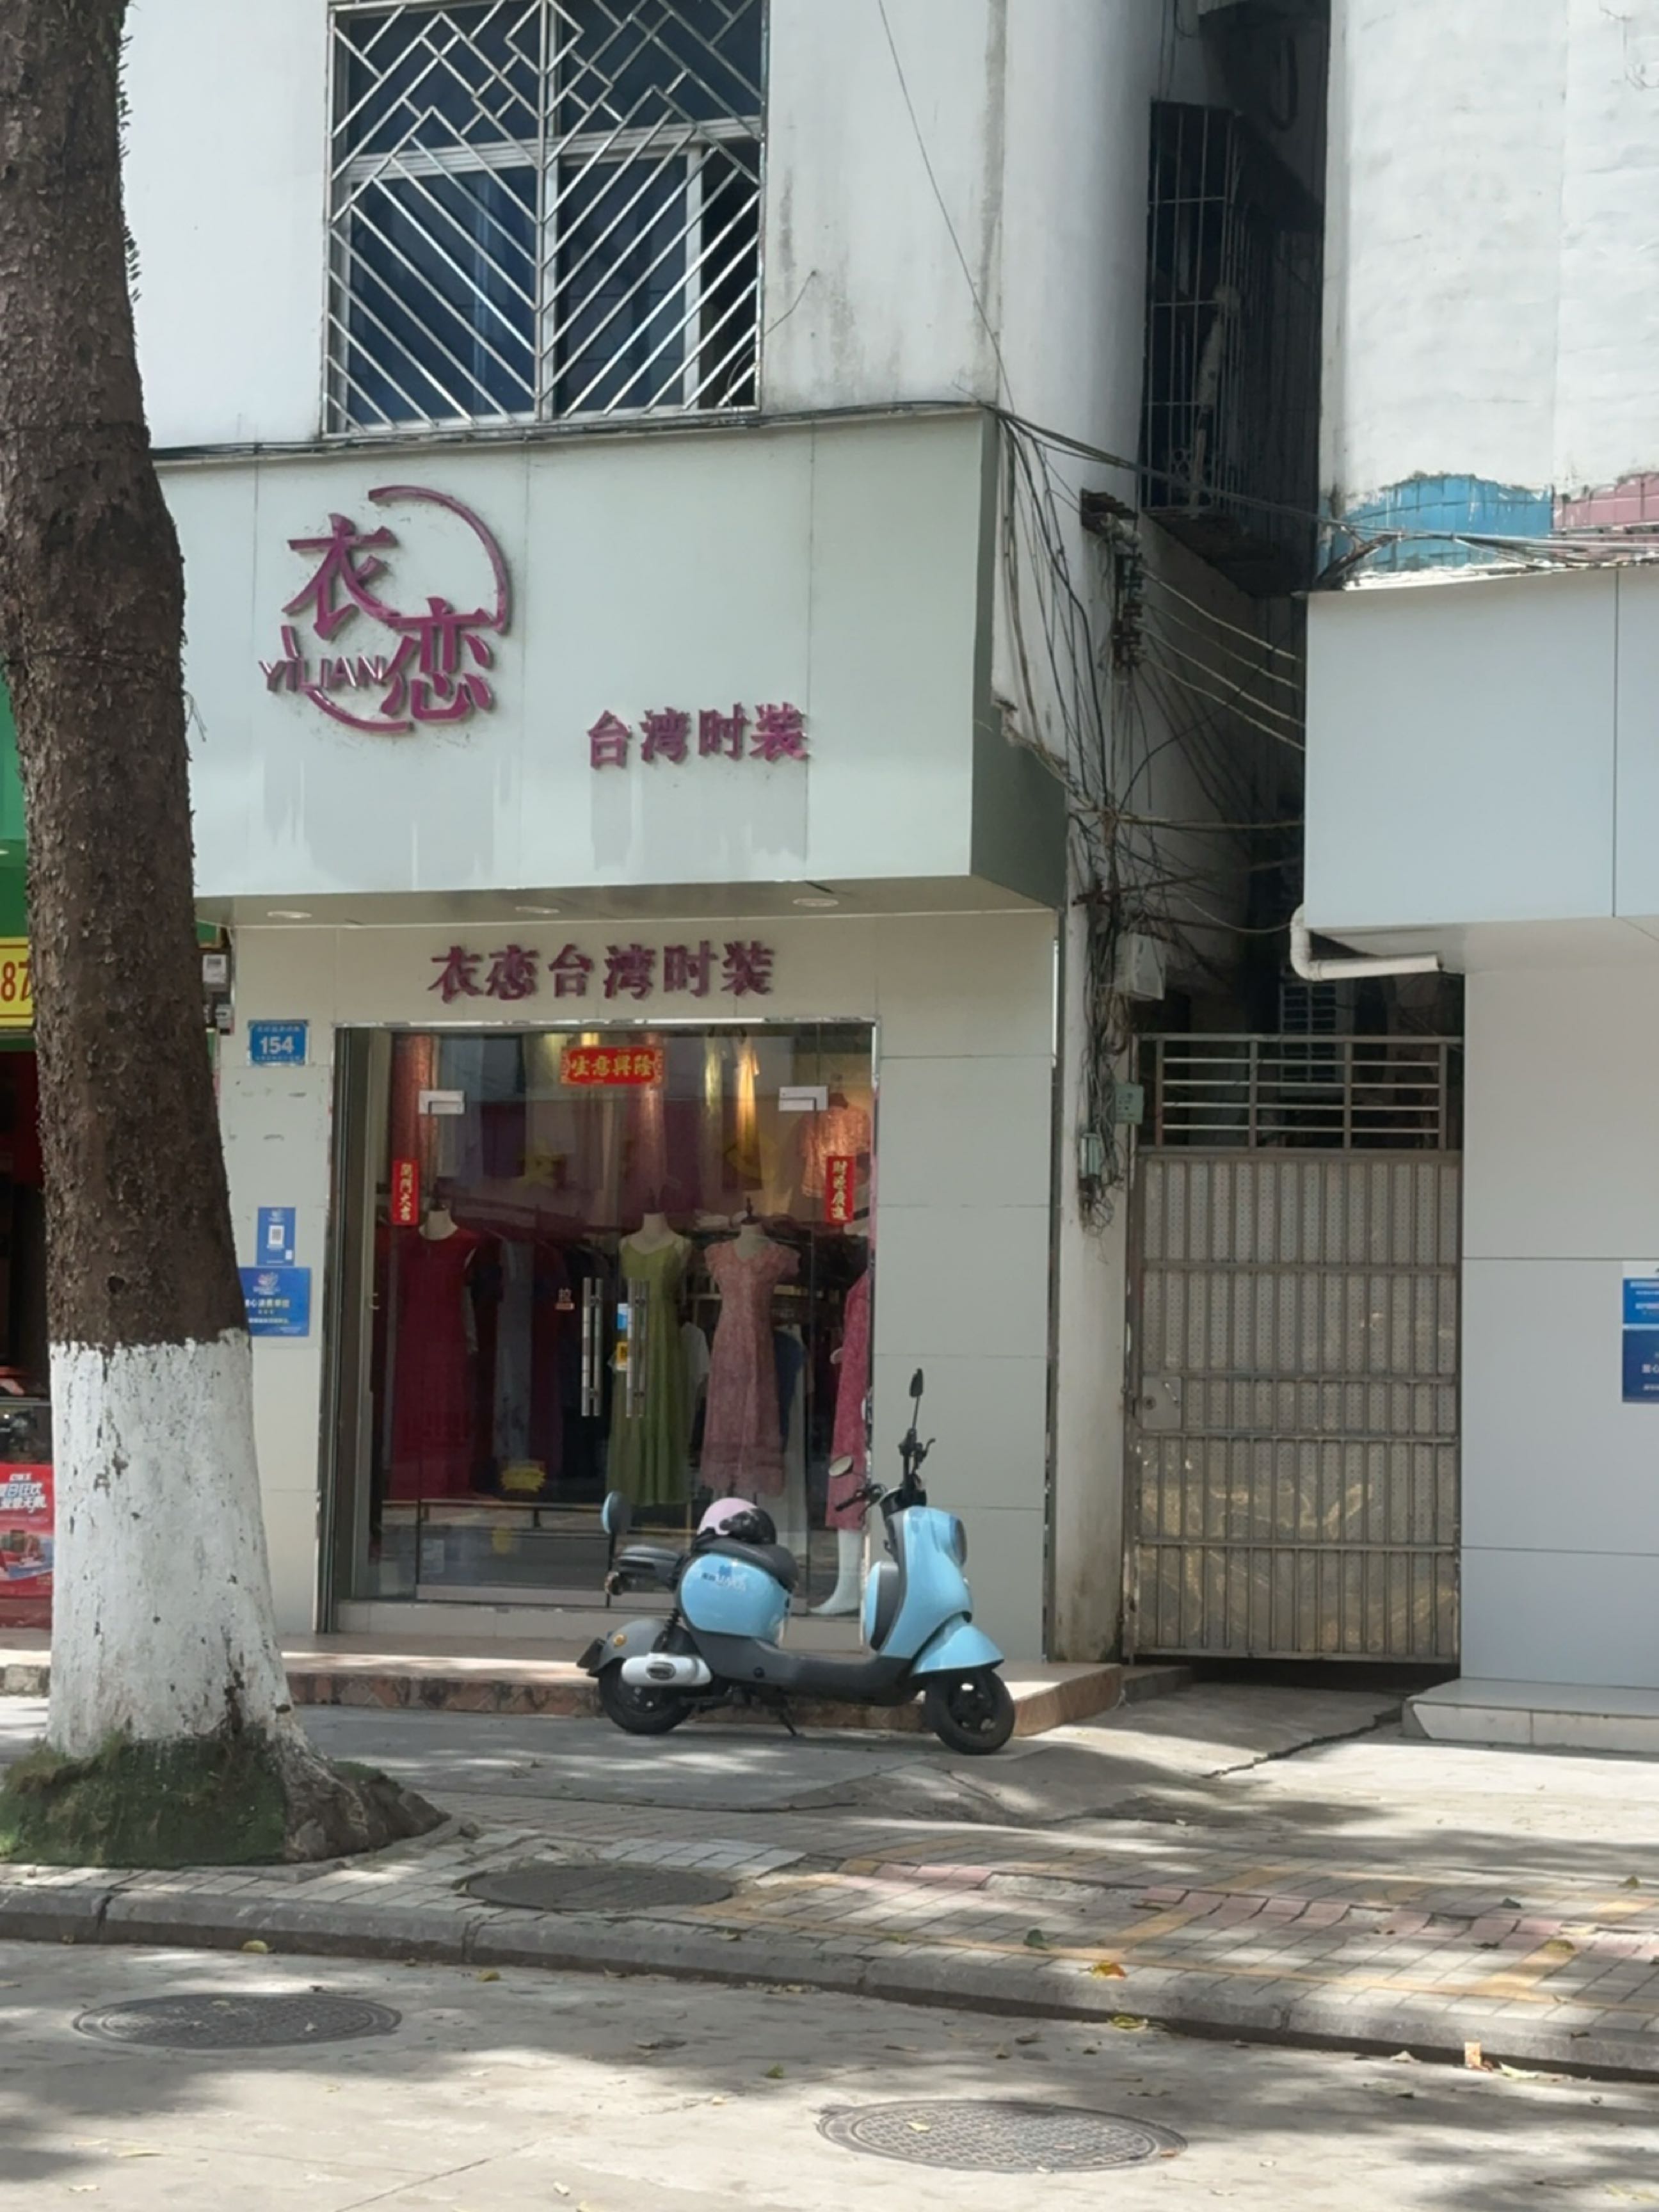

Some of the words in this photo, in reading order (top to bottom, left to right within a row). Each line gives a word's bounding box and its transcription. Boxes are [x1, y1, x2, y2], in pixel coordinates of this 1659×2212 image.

[282, 513, 494, 721] 衣恋
[258, 655, 389, 692] YILIAN
[587, 701, 808, 768] 台湾时装
[428, 940, 774, 1003] 衣恋台湾时装
[259, 1035, 294, 1055] 154
